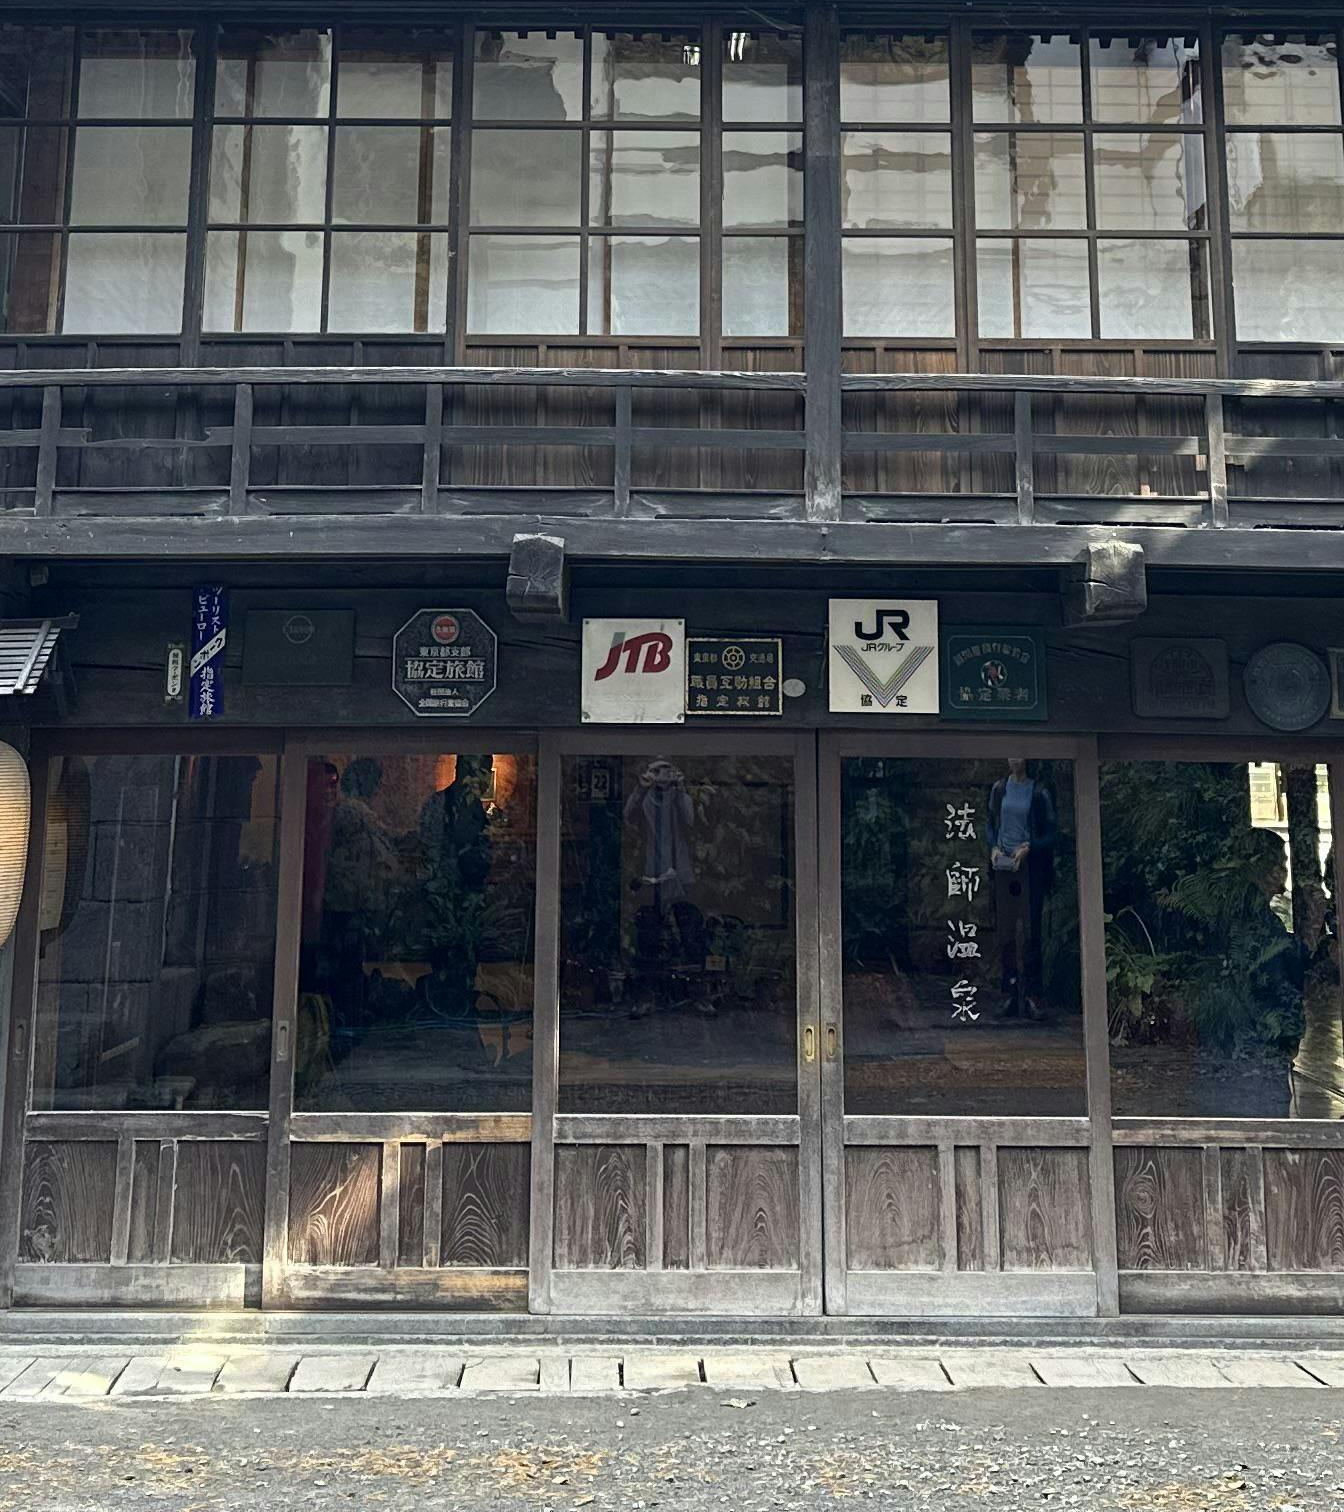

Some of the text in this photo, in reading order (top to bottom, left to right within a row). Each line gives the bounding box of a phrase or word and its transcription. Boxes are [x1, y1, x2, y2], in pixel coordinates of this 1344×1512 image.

[854, 609, 911, 641] JR
[594, 632, 673, 681] JTB
[860, 642, 905, 653] JRグループ
[405, 659, 486, 680] 協定旅館
[943, 802, 981, 1023] 法師温泉
